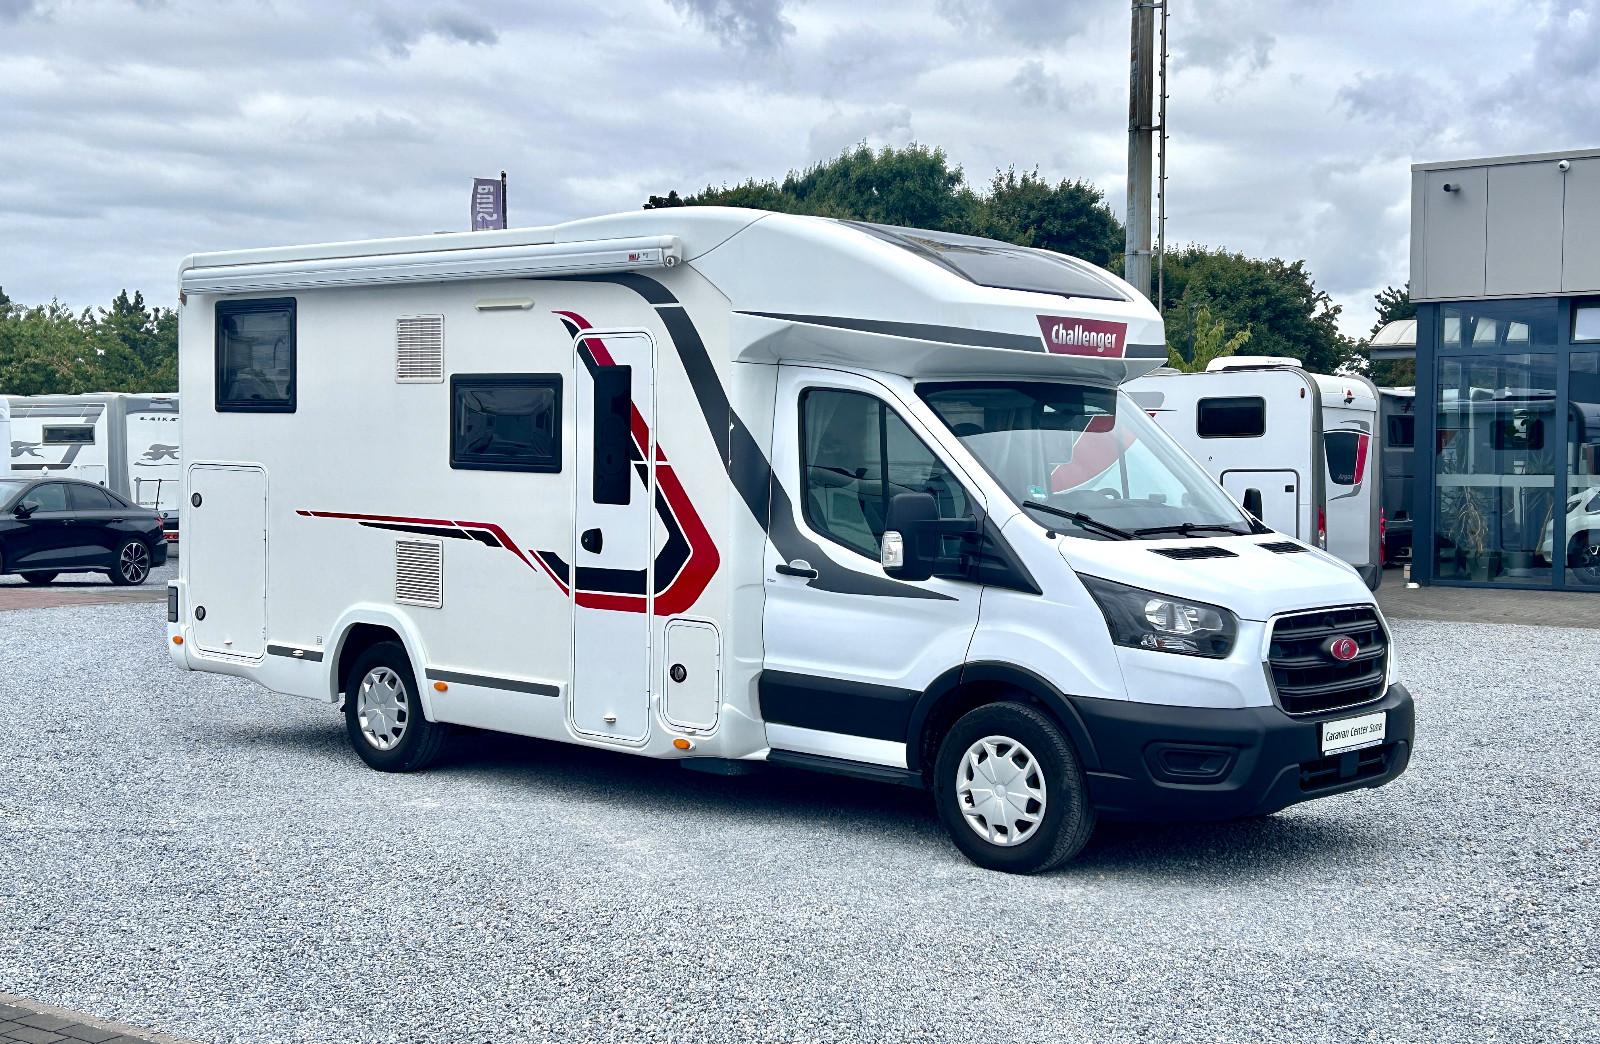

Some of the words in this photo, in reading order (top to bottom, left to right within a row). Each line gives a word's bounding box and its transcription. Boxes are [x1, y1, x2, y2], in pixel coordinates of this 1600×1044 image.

[1051, 323, 1117, 353] Challenger
[1326, 730, 1350, 741] Caravan
[1350, 725, 1369, 737] Center
